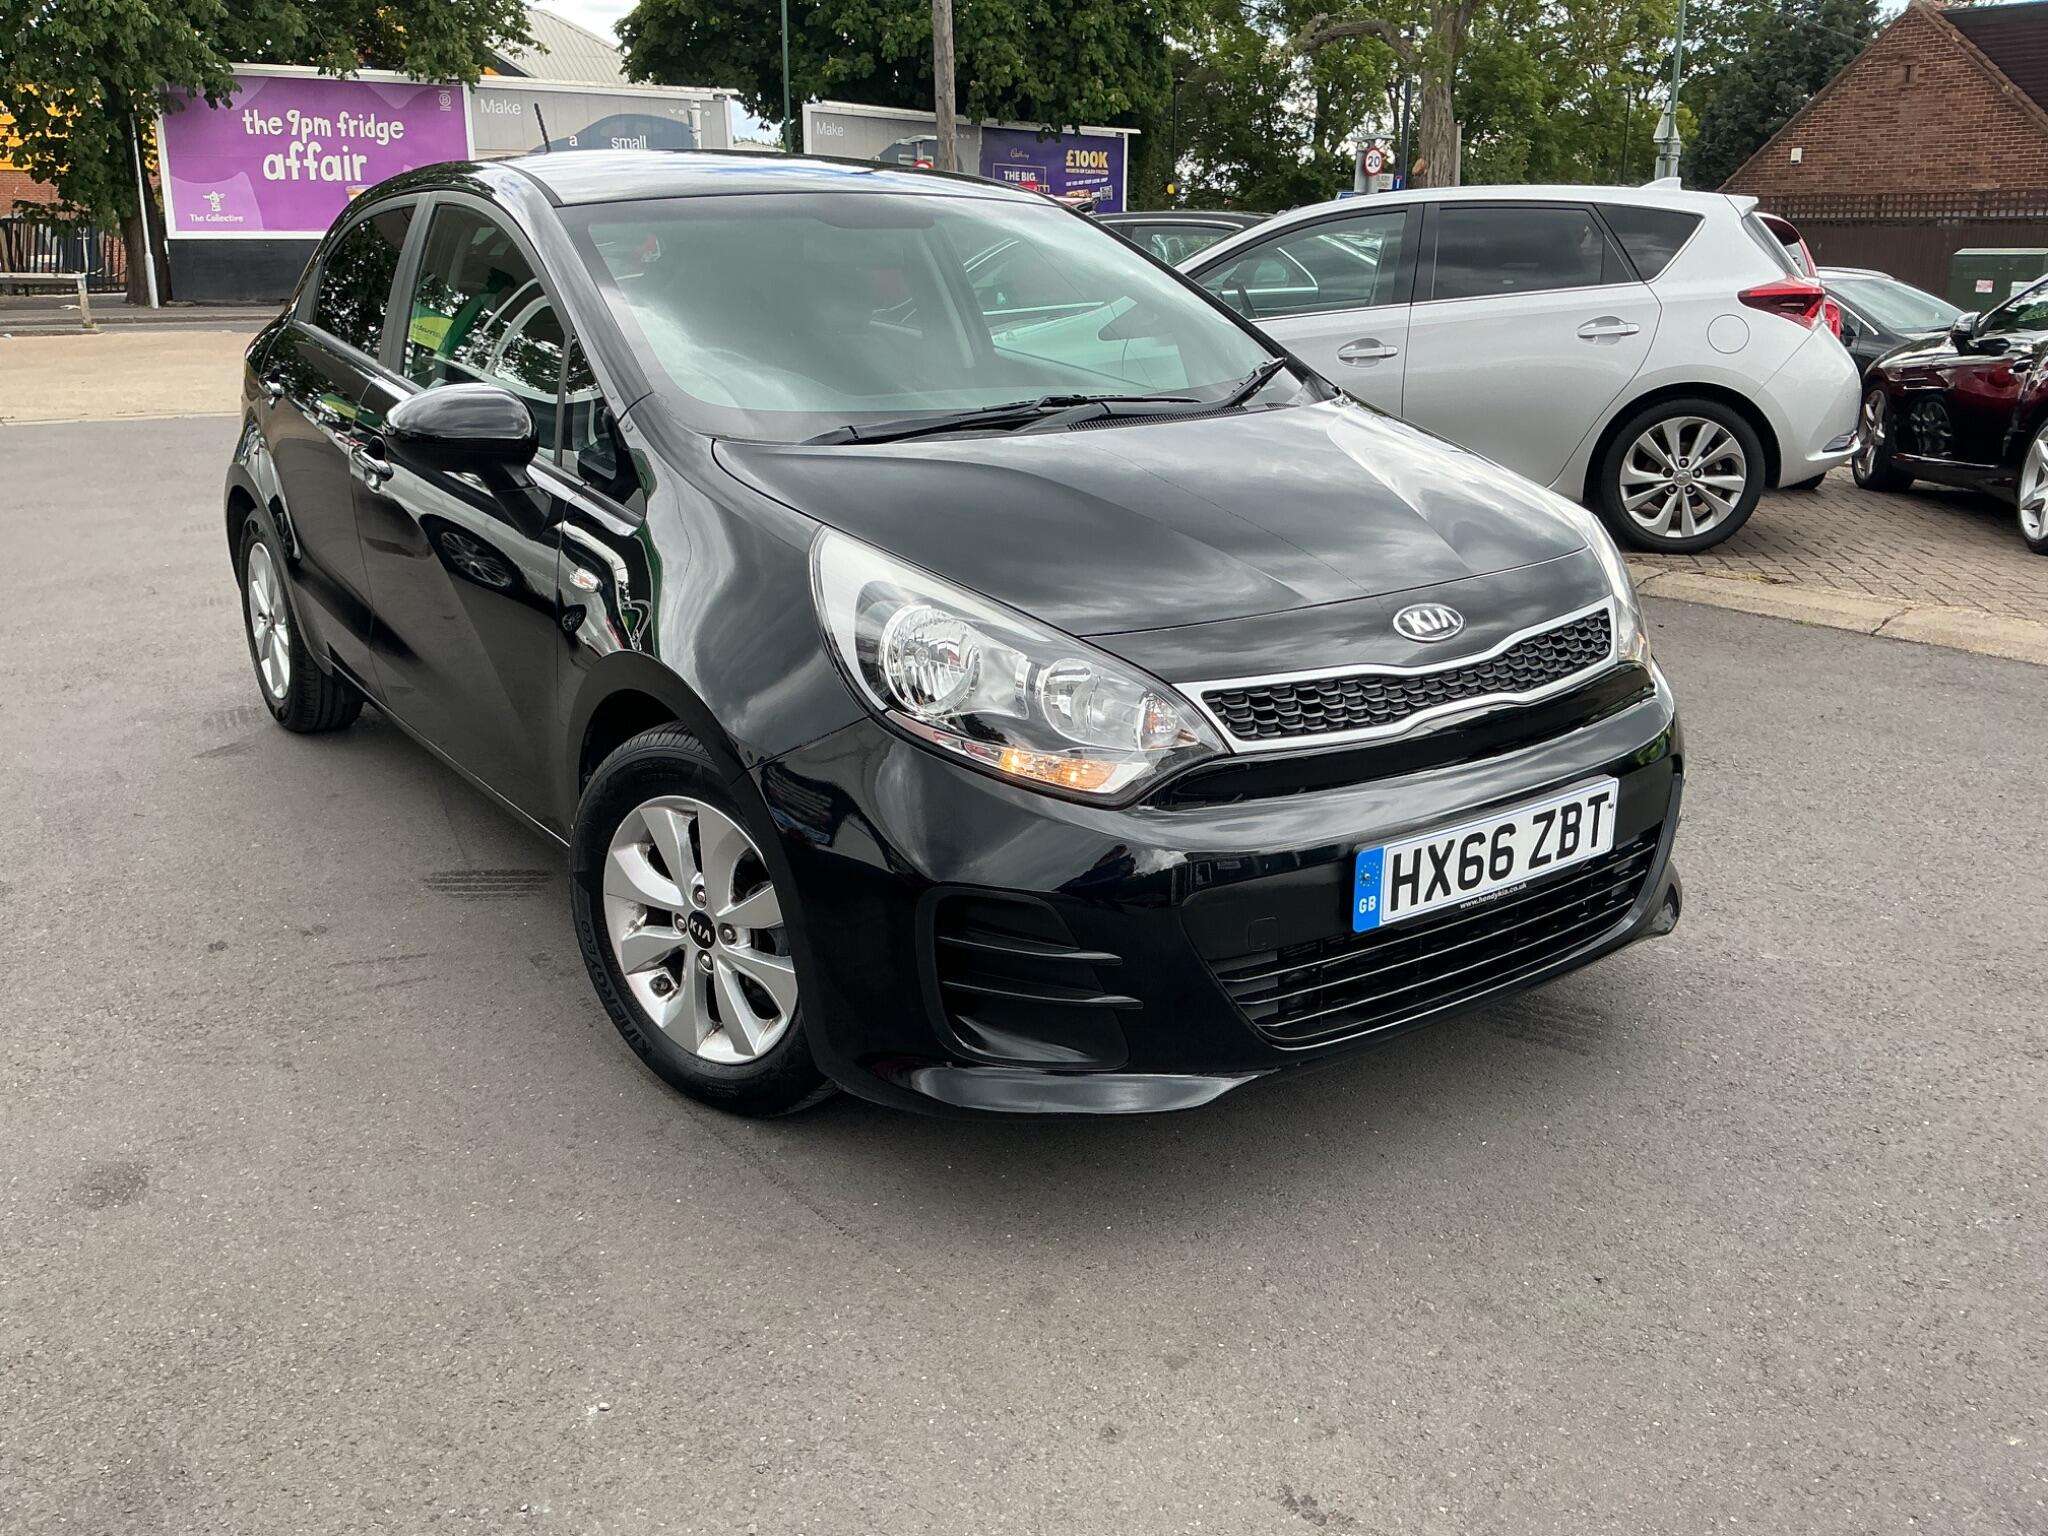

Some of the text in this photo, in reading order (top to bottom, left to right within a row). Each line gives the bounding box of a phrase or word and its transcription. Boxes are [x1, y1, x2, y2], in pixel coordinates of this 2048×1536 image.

[480, 98, 522, 116] Make
[242, 109, 405, 145] the 9pm fridge
[816, 121, 845, 137] Make
[569, 135, 648, 149] a small
[262, 141, 368, 181] affair
[1065, 149, 1109, 168] £100K
[1368, 155, 1380, 167] 20
[1004, 170, 1036, 182] THE BIG
[1402, 608, 1459, 634] KIA
[1390, 792, 1610, 912] HX66 ZBT
[1358, 896, 1376, 914] GB
[689, 918, 711, 942] KIA
